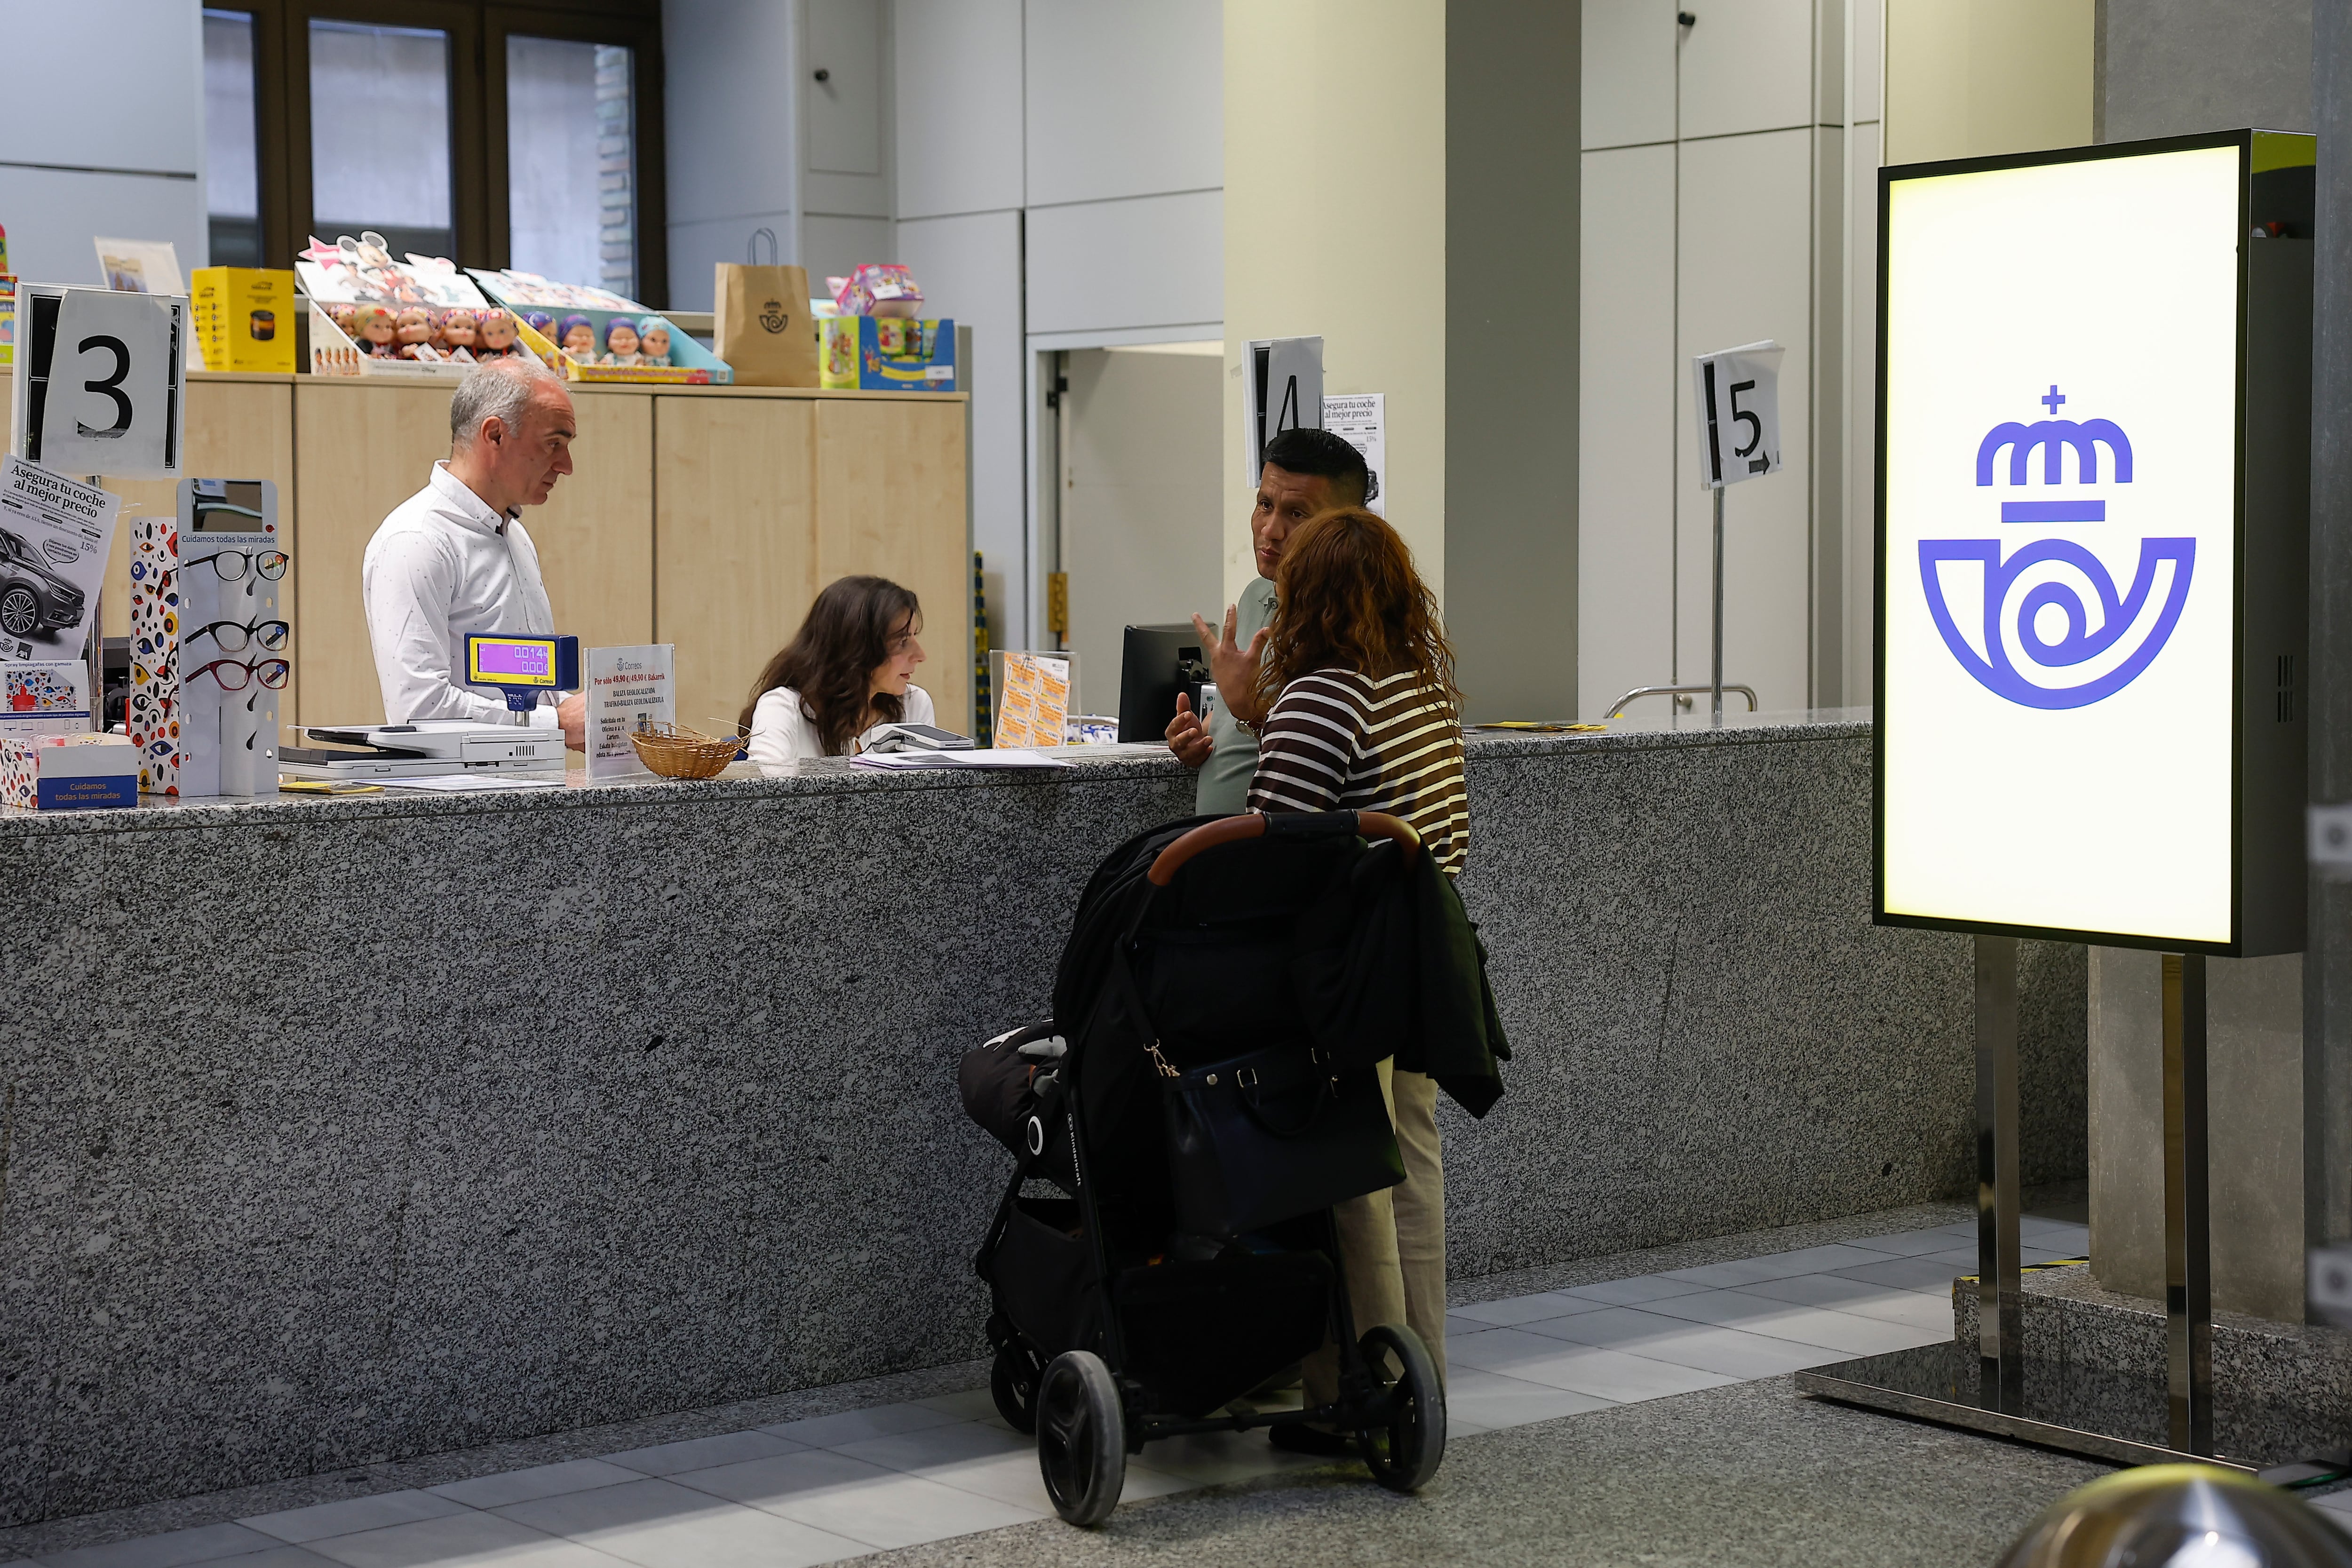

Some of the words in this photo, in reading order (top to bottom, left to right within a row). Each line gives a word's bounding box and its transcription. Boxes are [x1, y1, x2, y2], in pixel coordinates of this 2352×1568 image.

[77, 334, 133, 439] 3
[1357, 399, 1375, 408] coche
[1332, 409, 1351, 420] mejor
[1352, 408, 1372, 419] precio
[1730, 380, 1761, 458] 5
[11, 465, 57, 490] Asegura
[60, 483, 71, 495] tu
[73, 490, 105, 508] coche
[14, 479, 25, 490] al
[26, 488, 61, 503] mejor
[62, 499, 96, 517] precio
[80, 541, 96, 553] 15%
[16, 650, 28, 659] AXA
[613, 675, 626, 684] 49,90
[627, 687, 655, 696] GEOLOCALIZADA
[604, 699, 633, 708] TRAFIKO-BALIZA
[634, 696, 664, 705] GEOLOKALIZATUA
[1070, 1131, 1081, 1187] Kinderkraft
